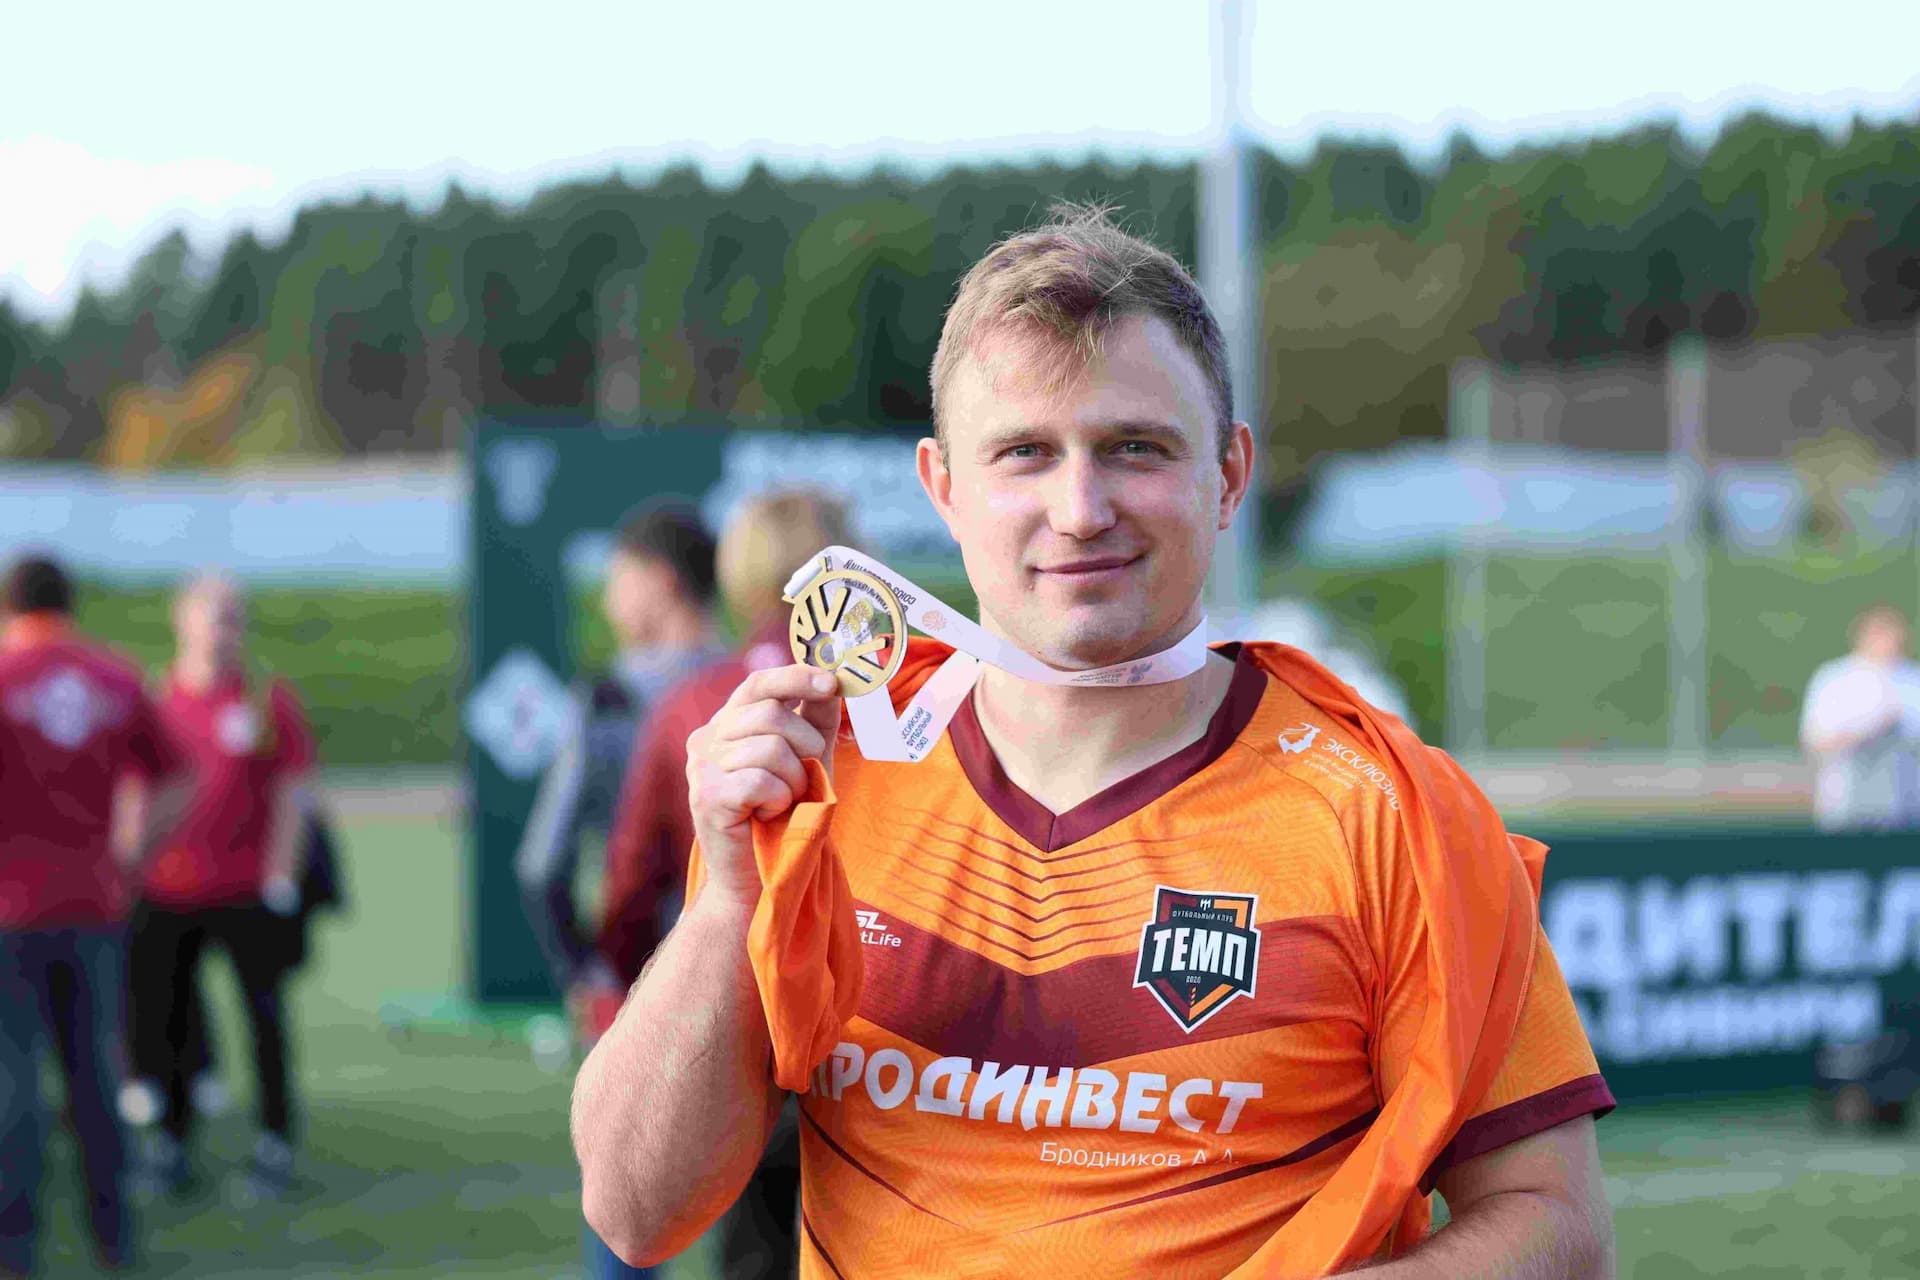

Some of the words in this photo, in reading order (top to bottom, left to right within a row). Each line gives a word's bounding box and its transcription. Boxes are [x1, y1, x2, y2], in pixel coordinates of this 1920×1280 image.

[1216, 914, 1233, 923] КЛУБ
[1151, 927, 1248, 981] ТЕМП
[1040, 1142, 1182, 1168] Бродников
